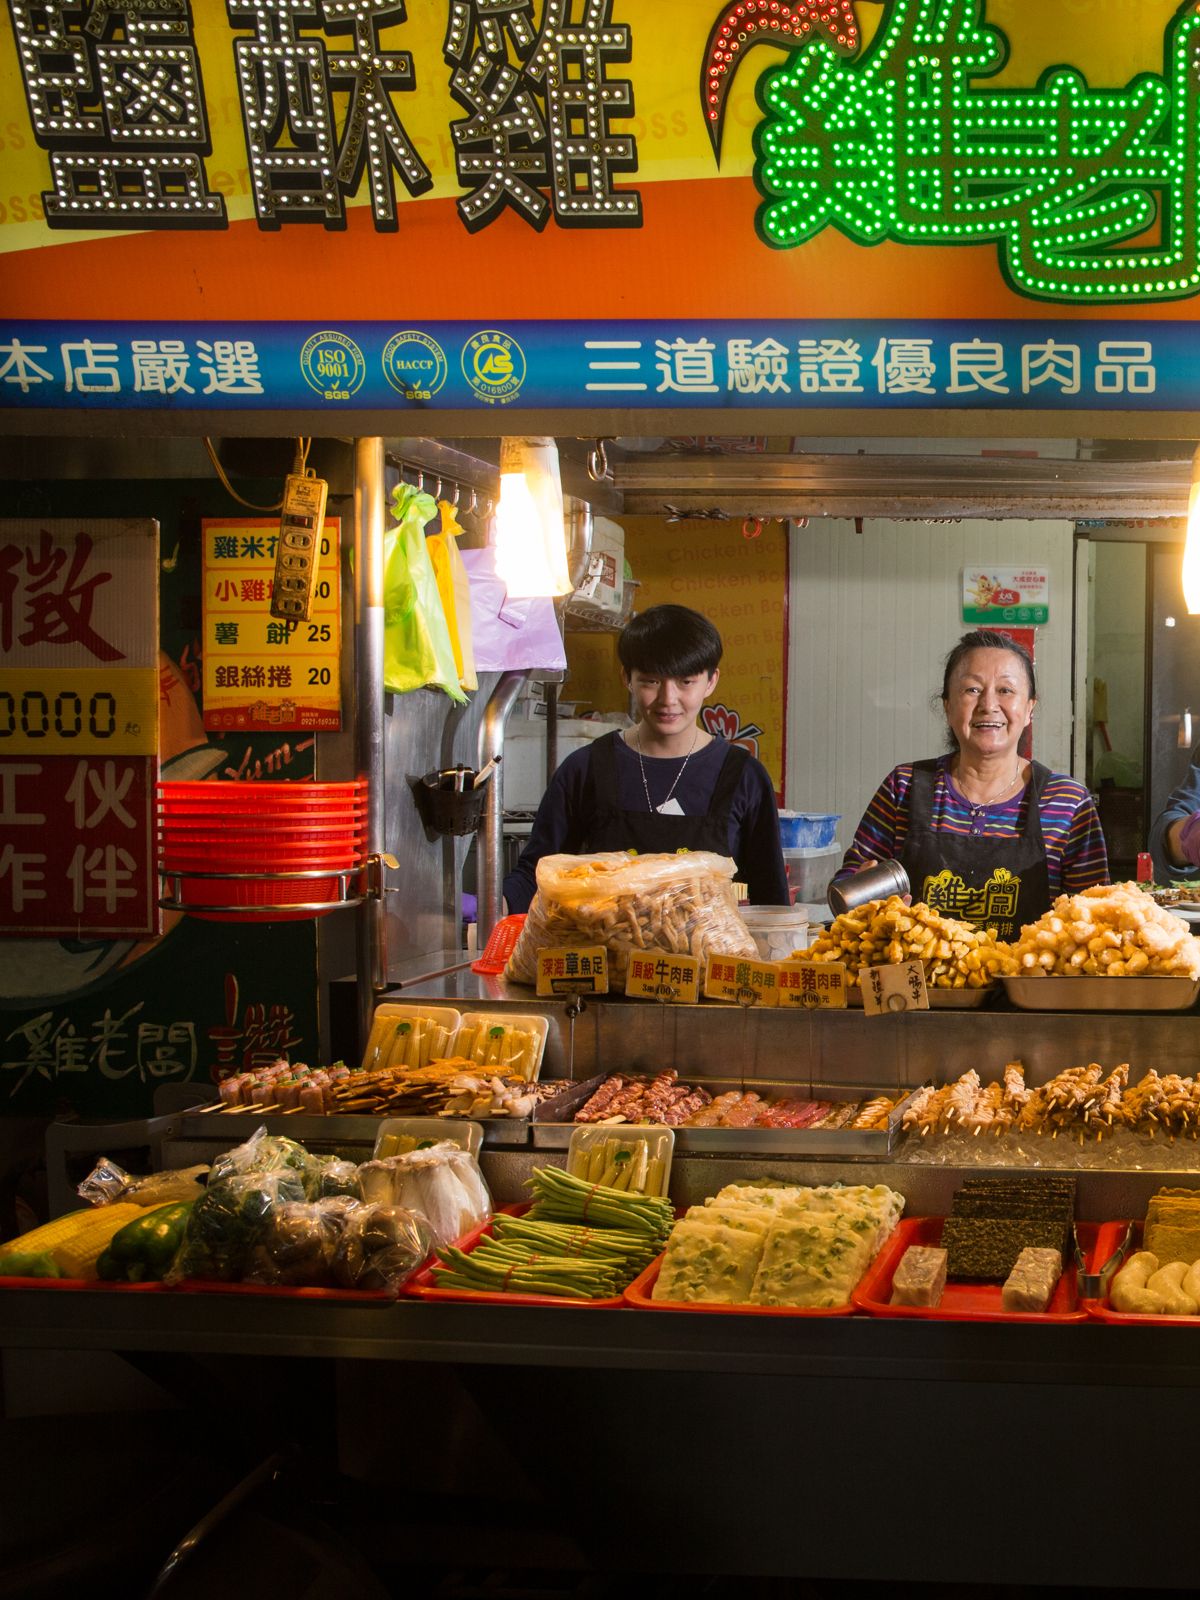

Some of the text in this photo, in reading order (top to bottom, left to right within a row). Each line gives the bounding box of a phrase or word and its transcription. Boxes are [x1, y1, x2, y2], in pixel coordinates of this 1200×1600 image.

[0, 339, 265, 396] 本店嚴選
[318, 349, 346, 363] ISO
[396, 359, 434, 370] HACCP
[583, 338, 1157, 397] 三道驗證優良肉品
[317, 363, 350, 378] 9001
[324, 390, 350, 400] SGS
[405, 390, 432, 400] SGS
[0, 529, 128, 663] 徵
[307, 624, 331, 643] 25
[214, 664, 292, 689] 銀絲捲
[307, 667, 331, 686] 20
[541, 951, 603, 979] 深海章魚足
[631, 959, 695, 986] 頂級牛肉串
[710, 962, 776, 990] 嚴選雞肉串
